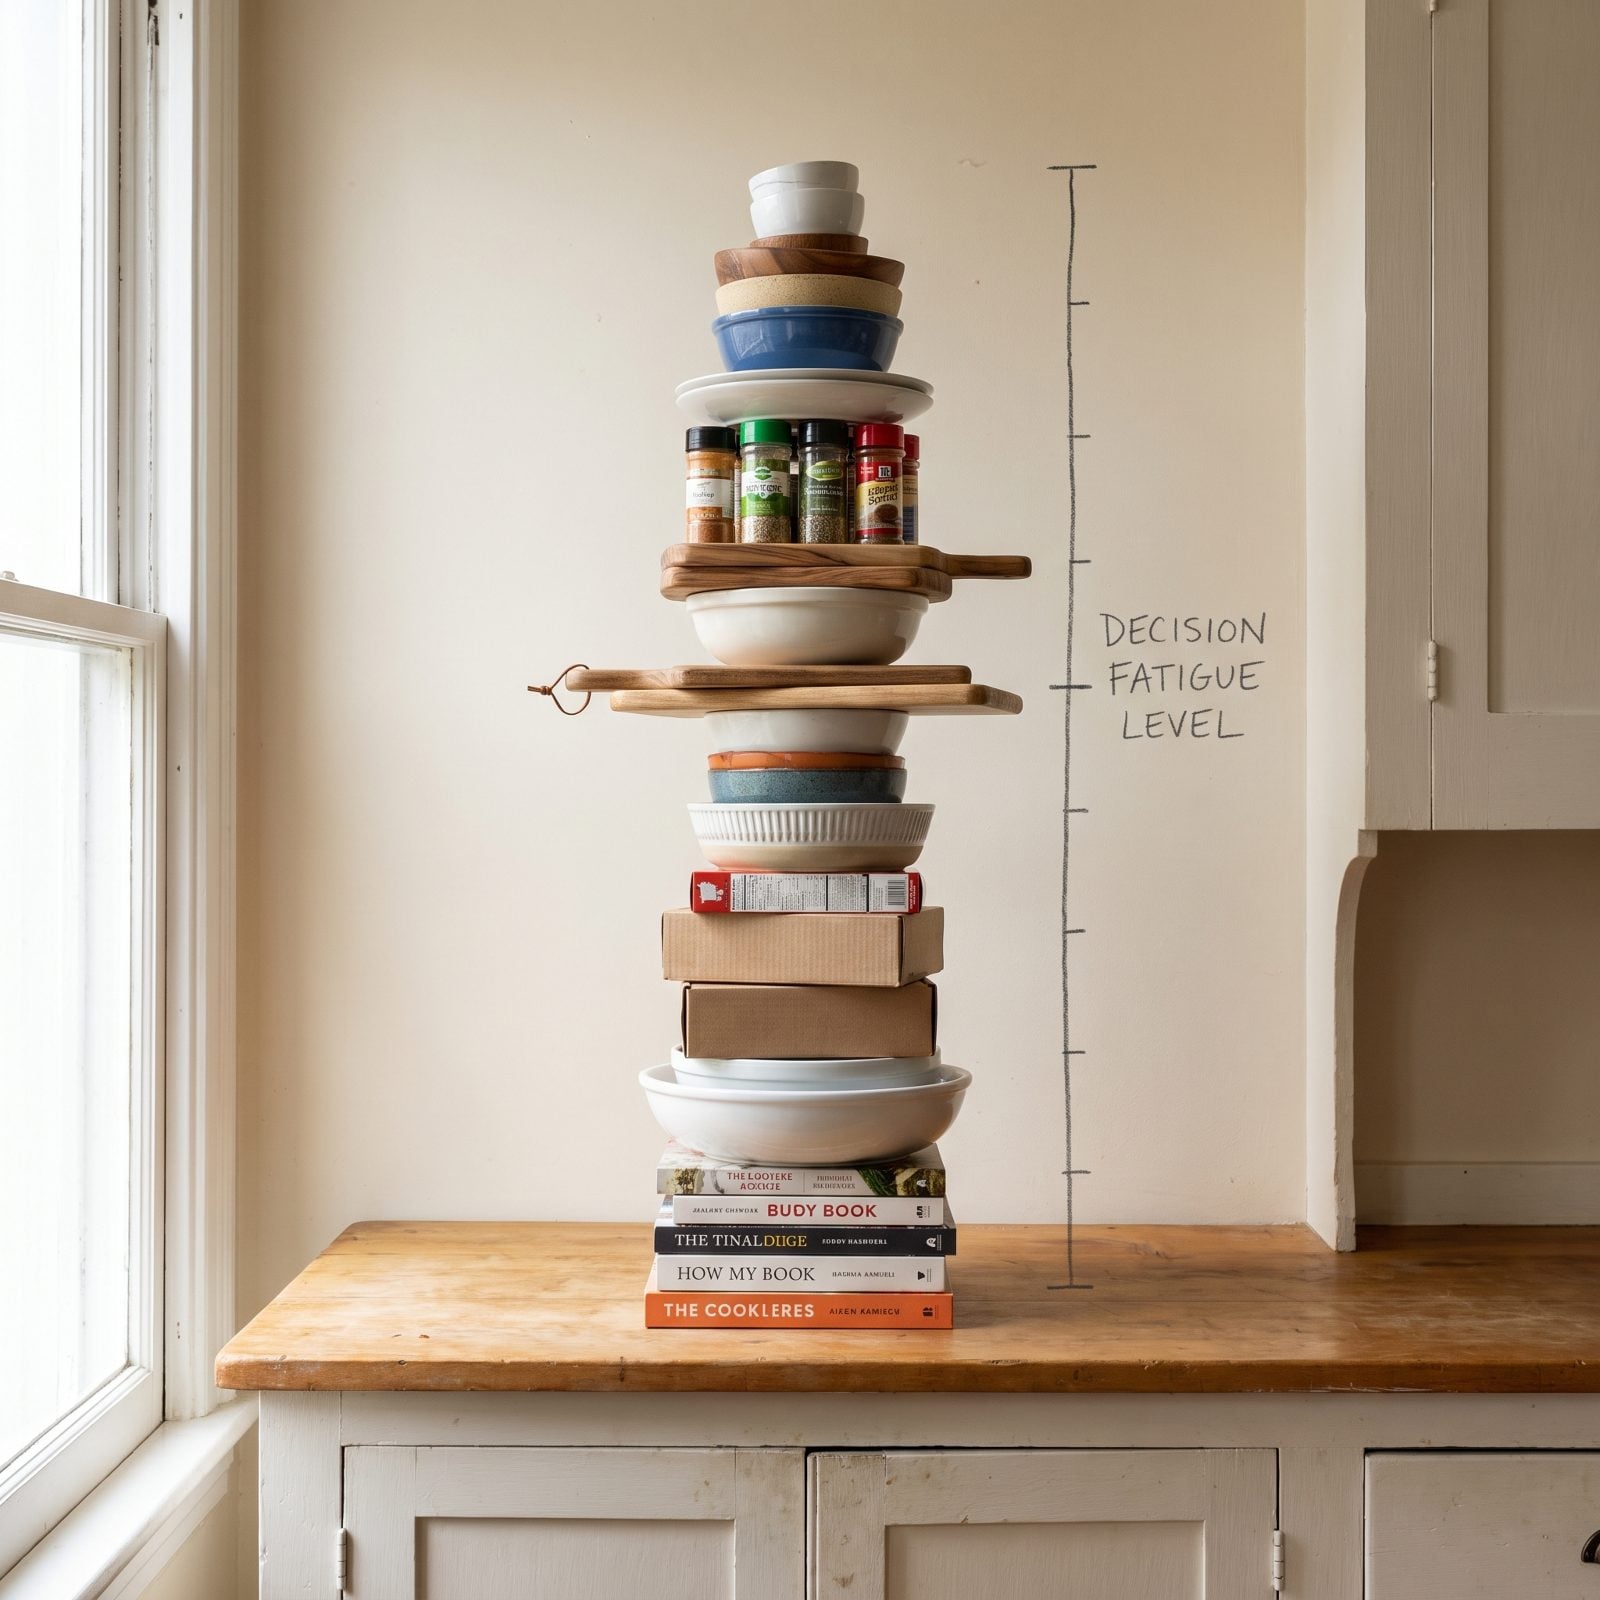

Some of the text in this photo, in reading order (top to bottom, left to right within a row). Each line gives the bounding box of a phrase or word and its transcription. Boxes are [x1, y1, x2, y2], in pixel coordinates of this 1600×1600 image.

[1099, 611, 1266, 647] DECISION
[1108, 660, 1266, 696] FATIGUE
[1122, 708, 1245, 740] LEVEL
[727, 1172, 745, 1181] THE
[767, 1204, 877, 1218] BUDY BOOK
[674, 1234, 709, 1247] THE
[677, 1266, 723, 1281] HOW
[729, 1266, 758, 1281] MY
[762, 1267, 816, 1281] BOOK
[663, 1303, 699, 1318] THE
[704, 1303, 815, 1318] COOKLERES
